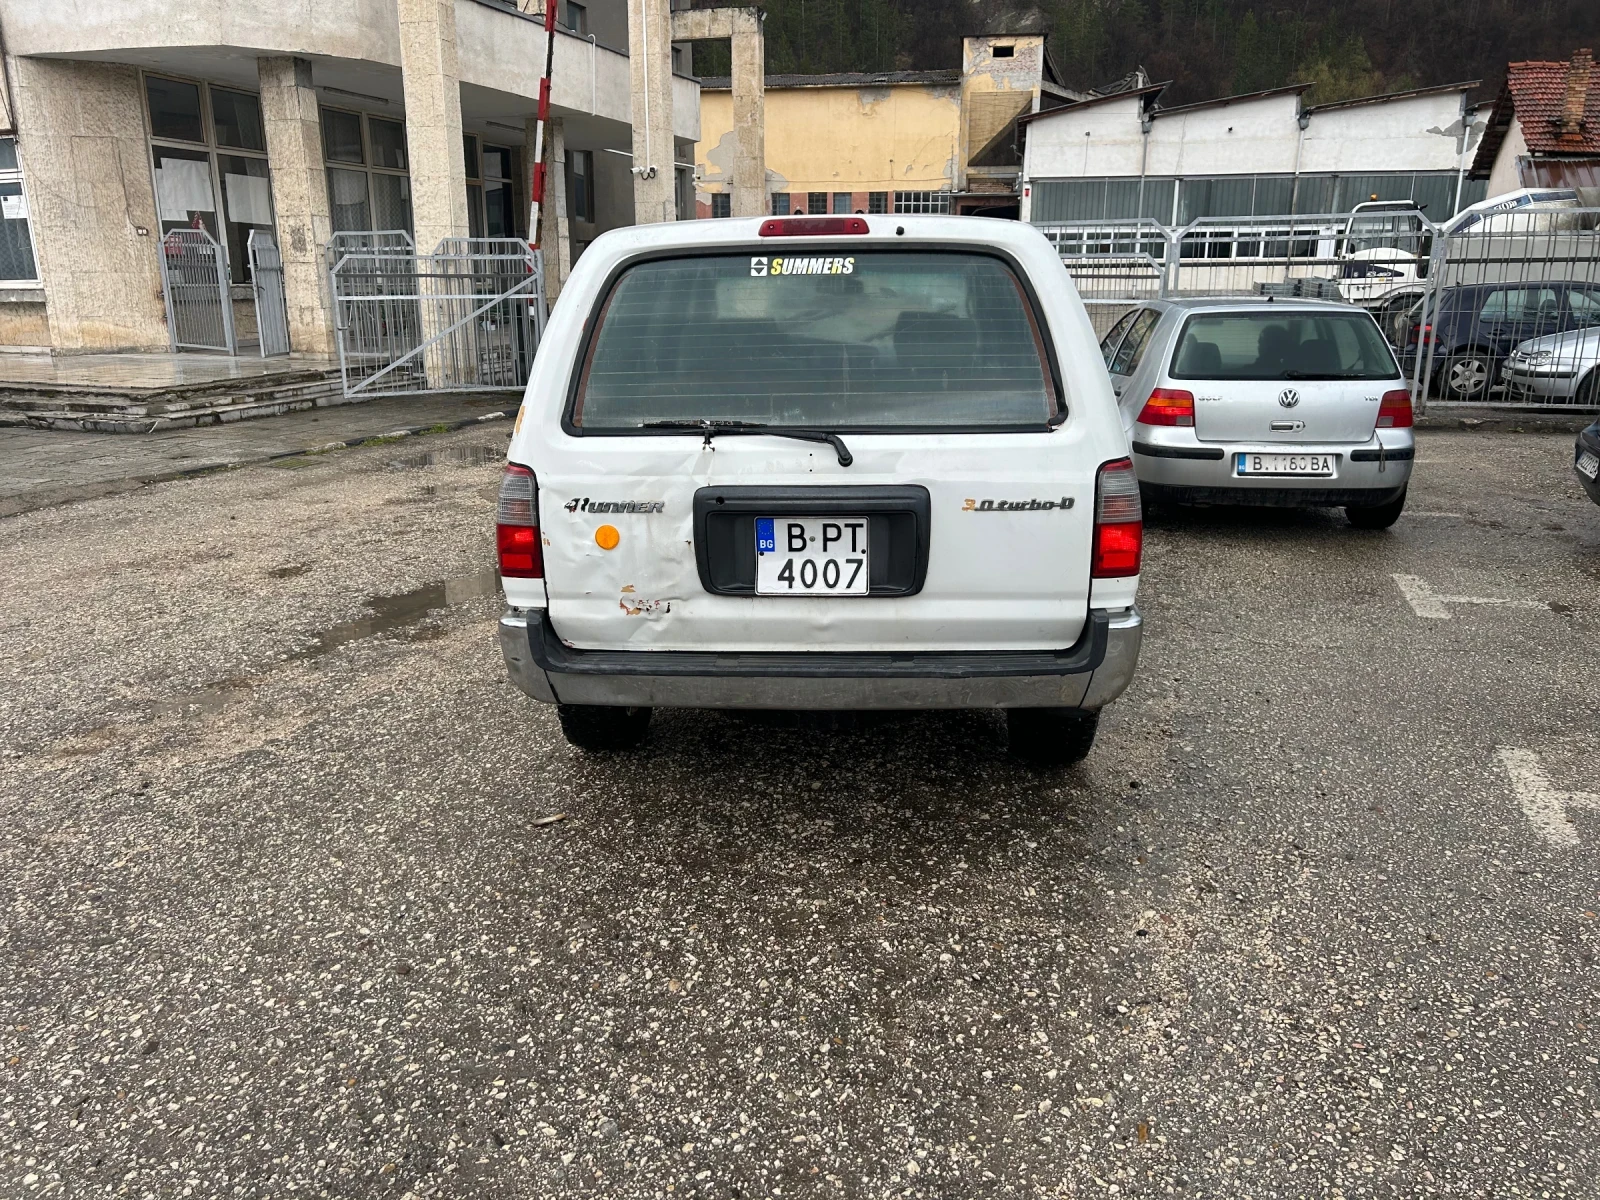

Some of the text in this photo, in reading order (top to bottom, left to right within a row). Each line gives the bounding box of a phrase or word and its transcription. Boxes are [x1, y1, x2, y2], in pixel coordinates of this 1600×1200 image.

[770, 257, 855, 276] SUMMERS
[759, 539, 774, 549] BG
[822, 523, 864, 553] PT
[777, 558, 864, 589] 4007
